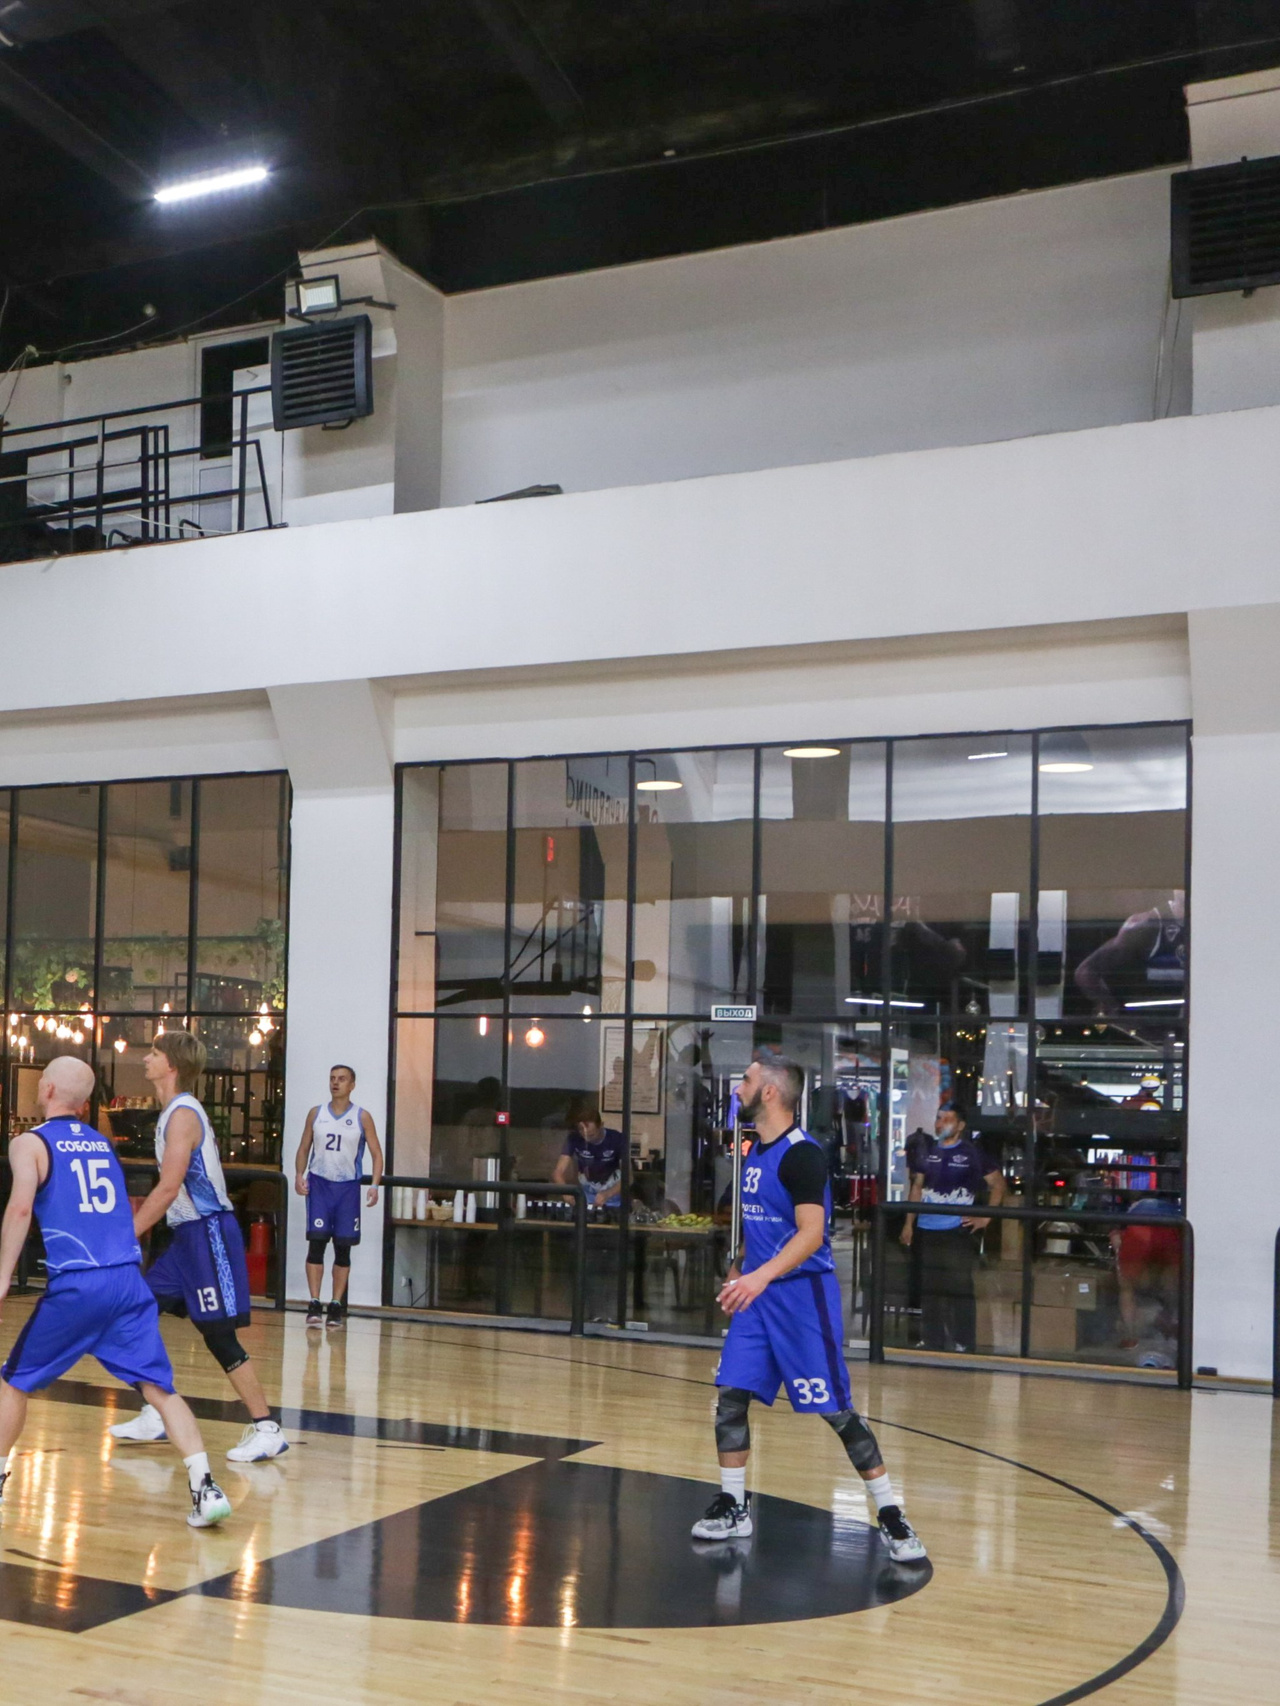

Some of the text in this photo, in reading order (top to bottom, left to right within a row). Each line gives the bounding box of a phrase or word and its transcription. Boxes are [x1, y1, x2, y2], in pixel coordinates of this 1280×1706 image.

[716, 1009, 753, 1018] ВЫХОД
[325, 1133, 342, 1152] 21
[70, 1158, 116, 1213] 15
[742, 1166, 762, 1194] 33
[197, 1286, 219, 1313] 13
[793, 1378, 830, 1404] 33
